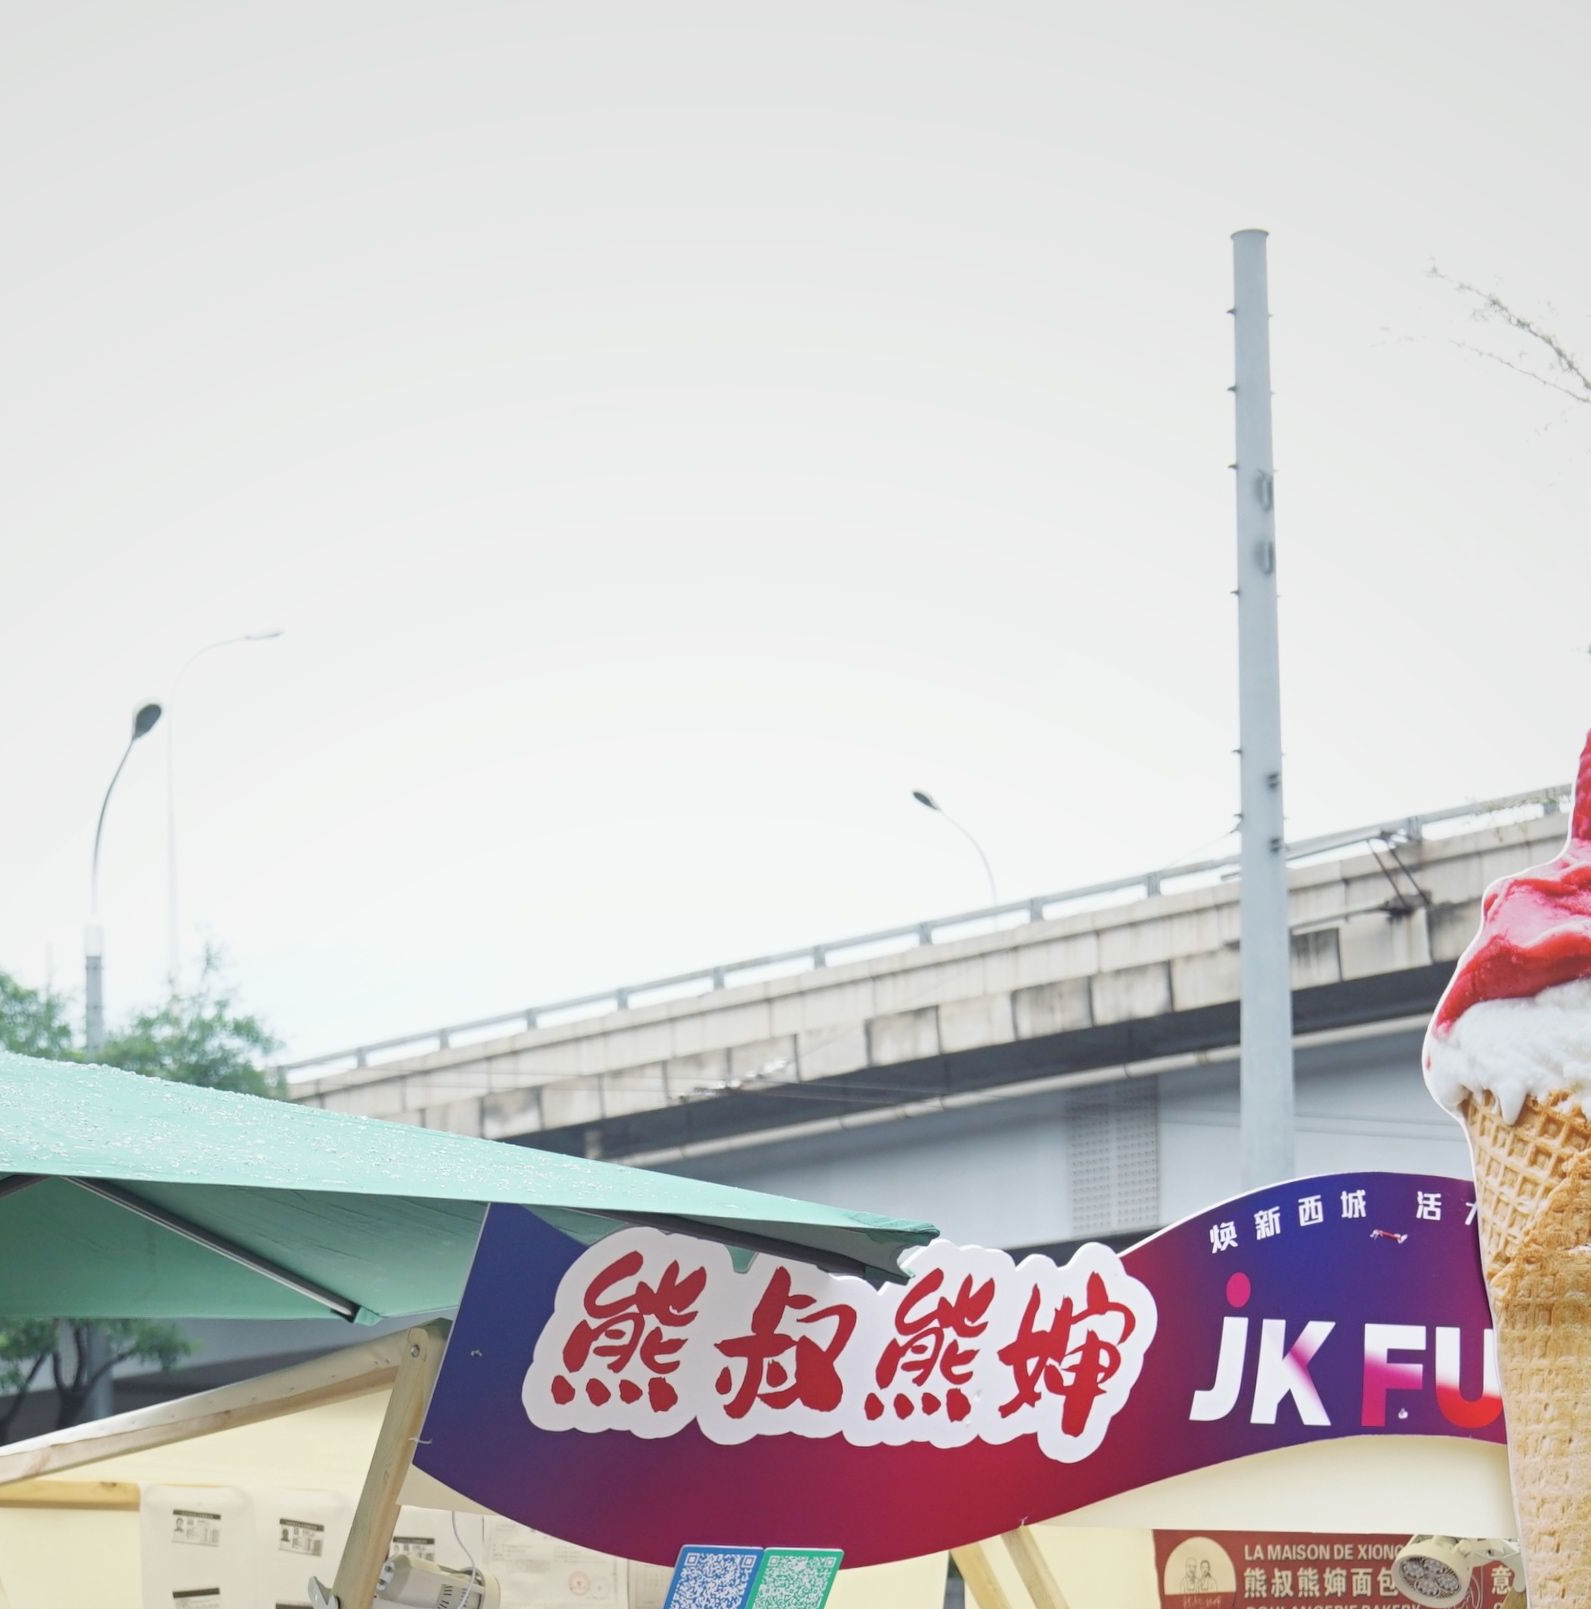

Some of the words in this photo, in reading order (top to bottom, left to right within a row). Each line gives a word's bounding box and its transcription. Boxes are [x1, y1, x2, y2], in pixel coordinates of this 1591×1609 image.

[1209, 1189, 1367, 1254] 焕新西城
[1360, 1322, 1504, 1430] FU
[1244, 1544, 1265, 1561] LA
[1267, 1543, 1332, 1561] MAISON
[1334, 1544, 1355, 1561] DE
